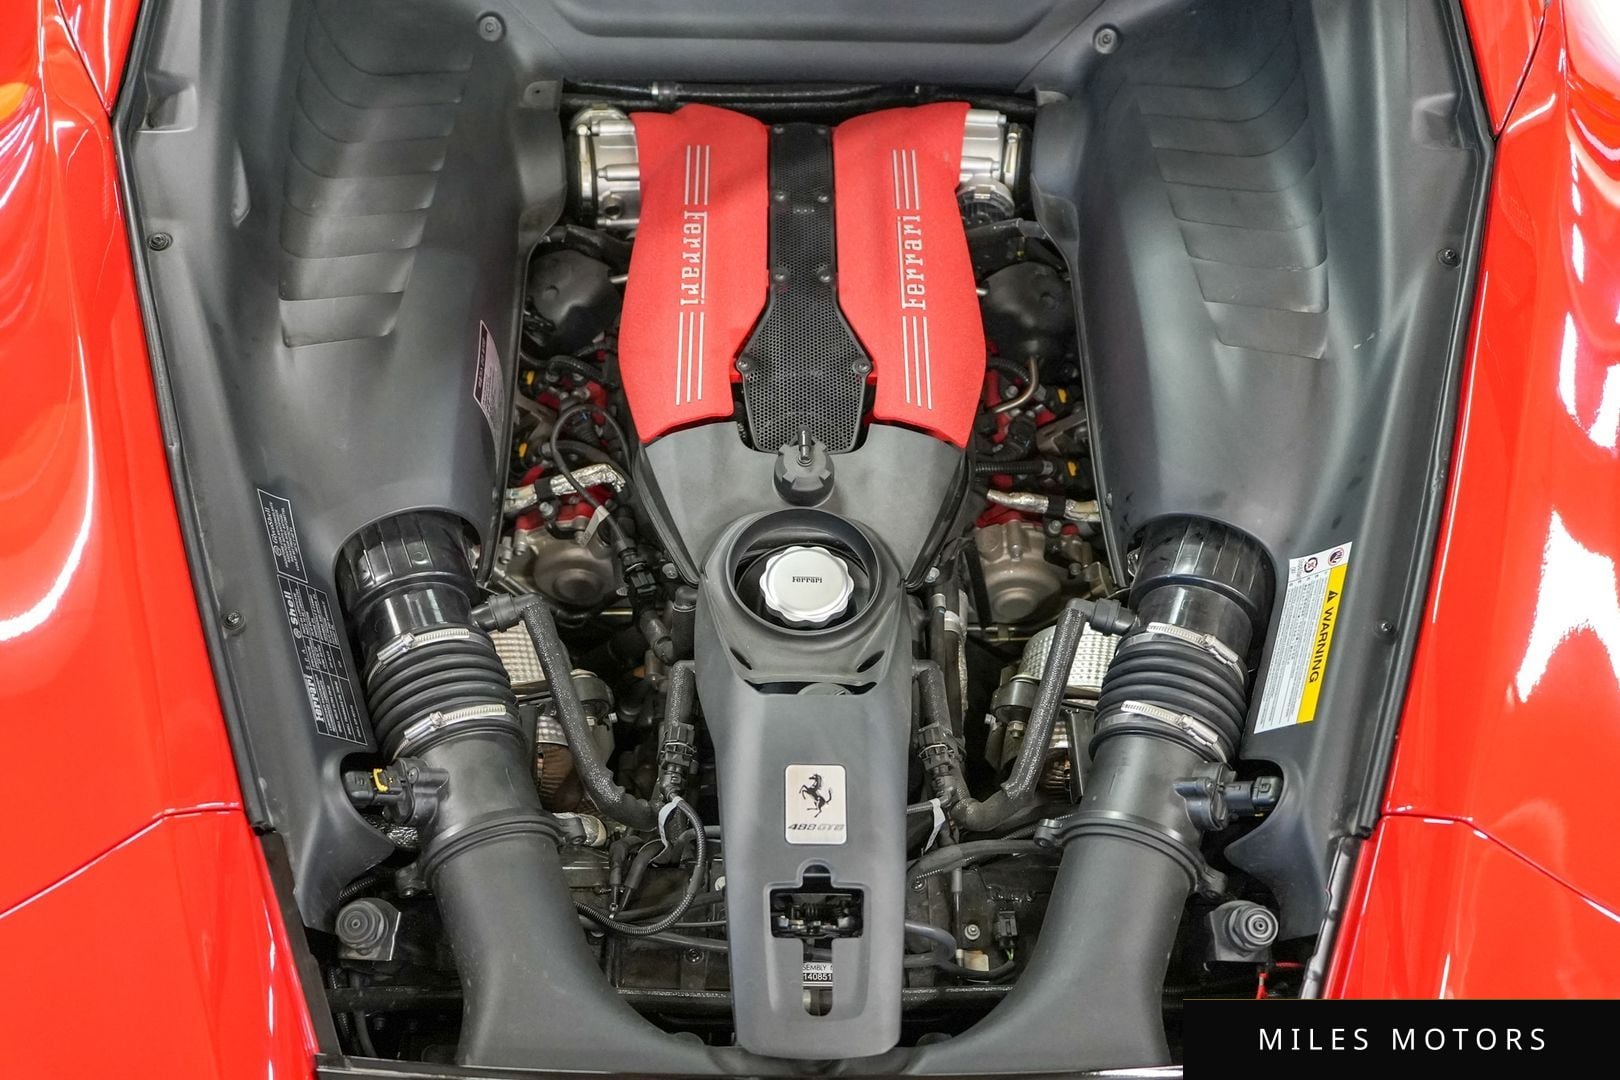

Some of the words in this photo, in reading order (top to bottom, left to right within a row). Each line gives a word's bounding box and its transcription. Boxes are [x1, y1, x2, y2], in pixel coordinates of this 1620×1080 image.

[680, 210, 708, 306] Ferrari
[897, 214, 926, 310] Ferrari
[791, 575, 823, 584] Ferrari
[283, 590, 299, 626] Shell
[1308, 606, 1335, 684] WARNING
[303, 673, 325, 723] Ferrari
[803, 973, 832, 981] 140851
